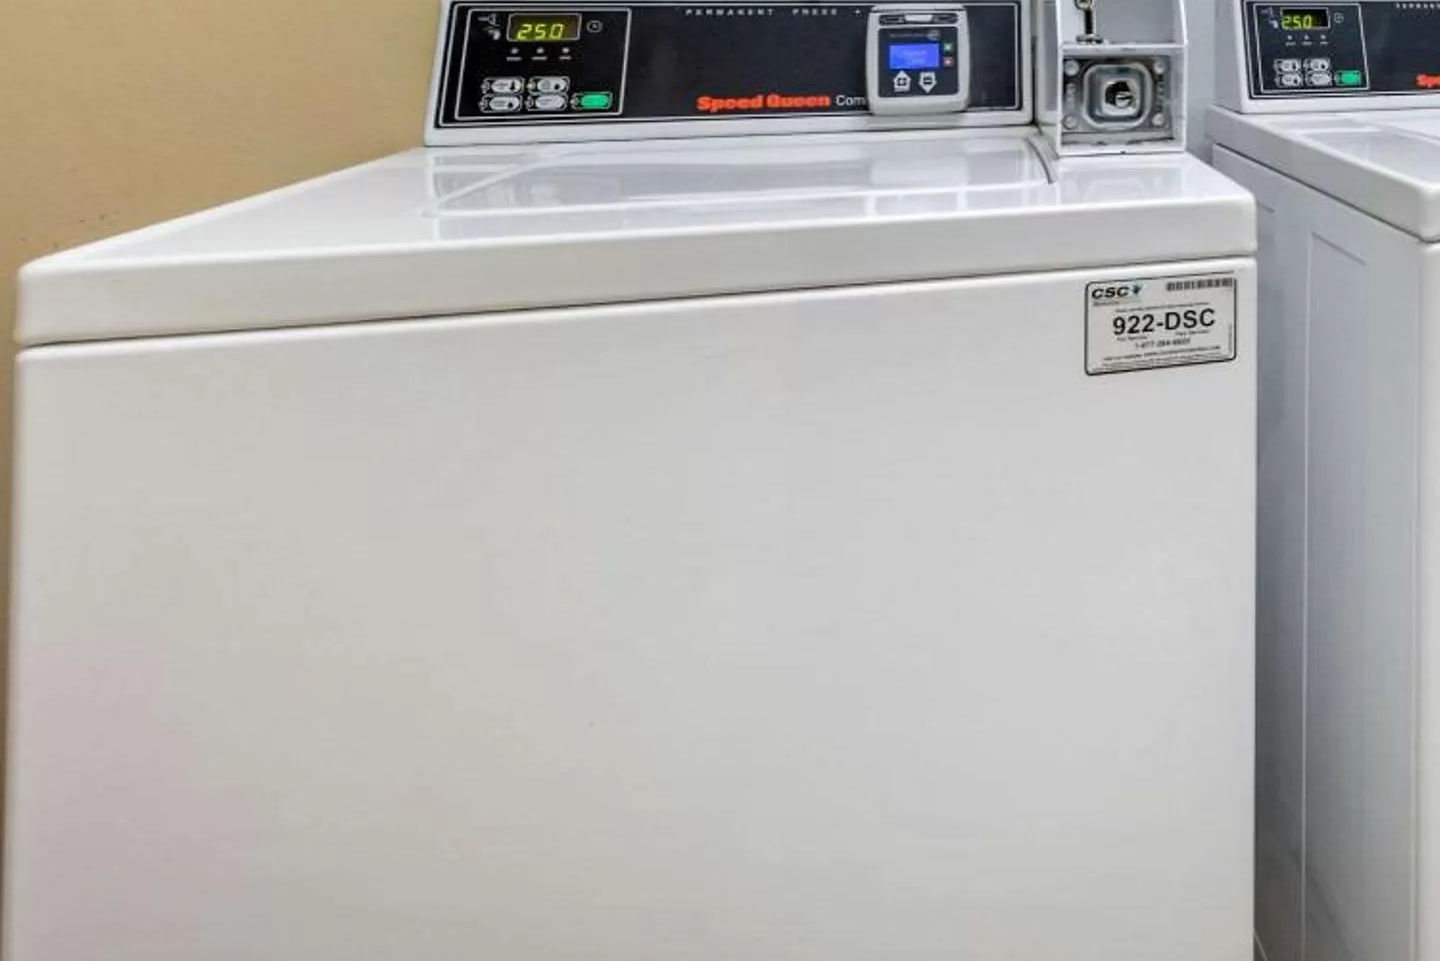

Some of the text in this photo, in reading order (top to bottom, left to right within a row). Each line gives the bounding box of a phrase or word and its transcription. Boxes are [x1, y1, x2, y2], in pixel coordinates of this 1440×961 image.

[1281, 14, 1312, 30] 250
[517, 23, 565, 40] 250
[697, 94, 764, 113] Speed
[767, 92, 832, 109] Queen
[1091, 286, 1130, 299] CSC
[1113, 308, 1215, 335] 922-DSC
